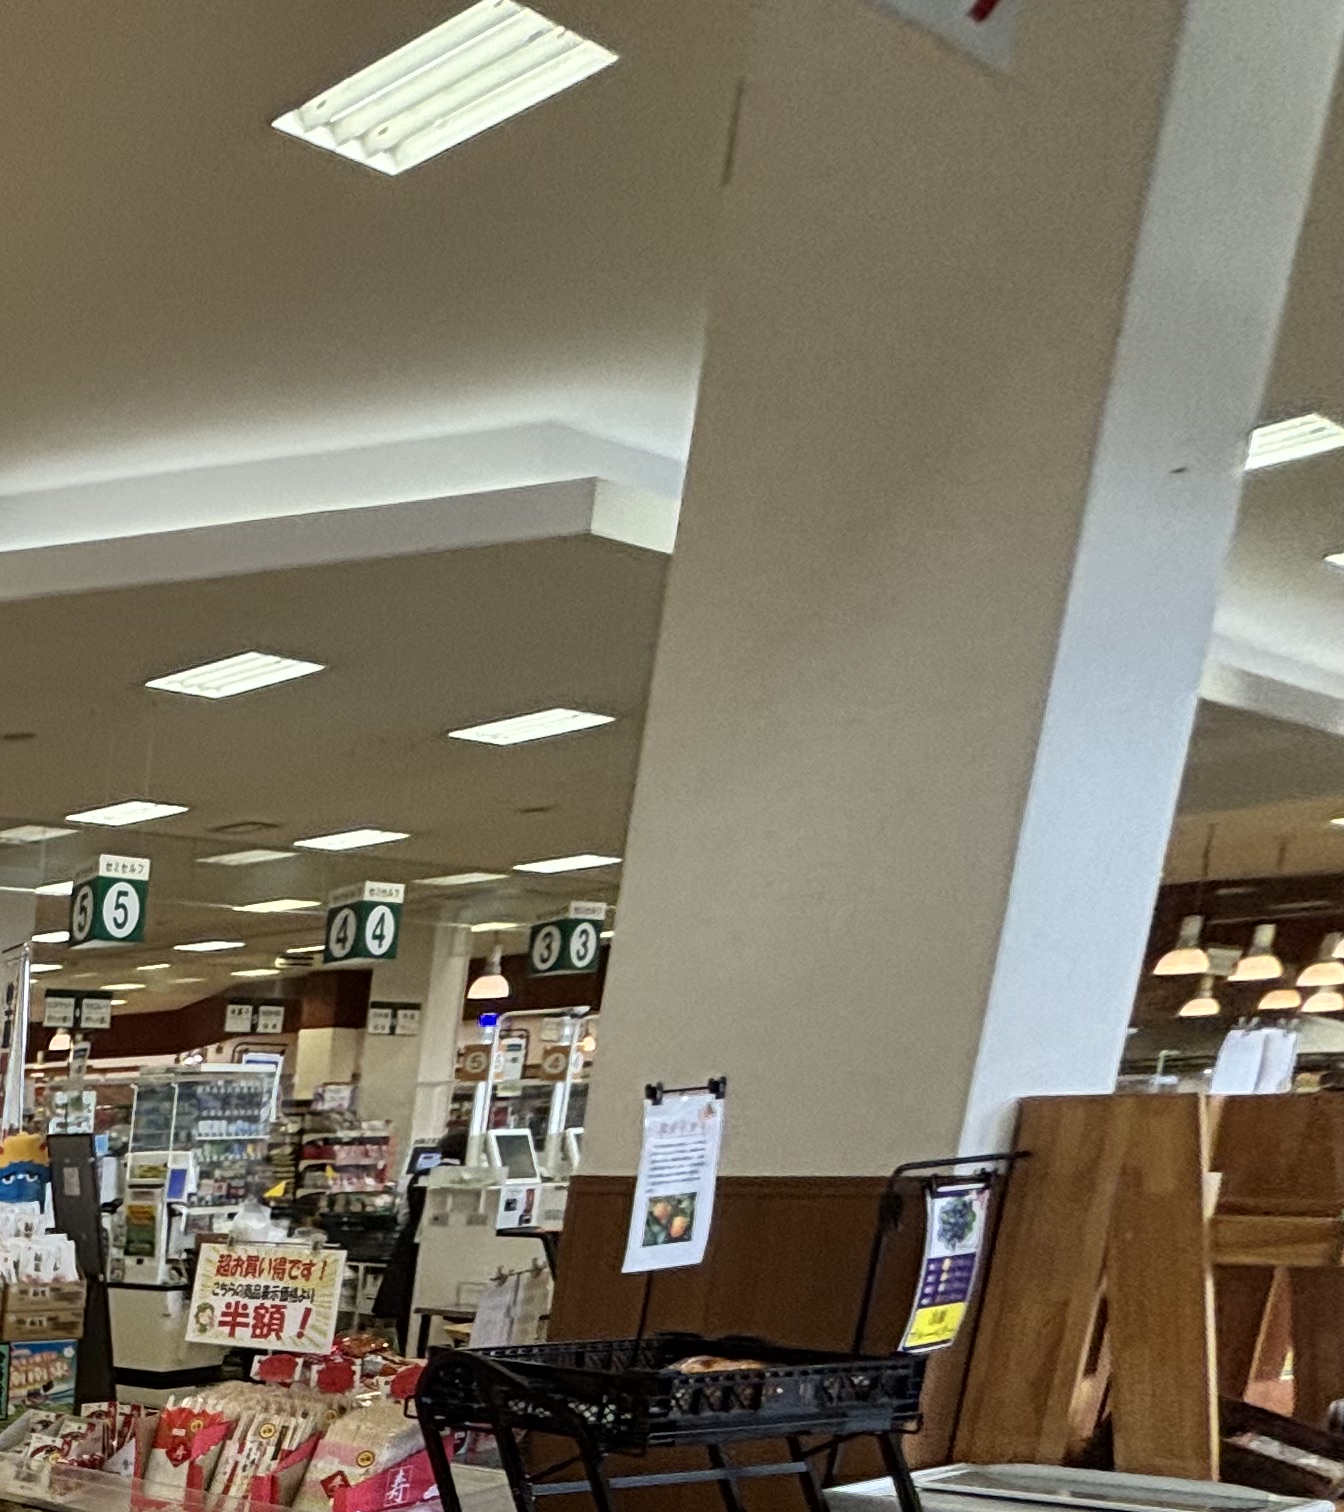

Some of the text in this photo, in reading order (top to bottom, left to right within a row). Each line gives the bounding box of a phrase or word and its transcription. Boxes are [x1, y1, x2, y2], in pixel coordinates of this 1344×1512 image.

[113, 888, 130, 931] 5
[372, 910, 389, 949] 4
[577, 928, 591, 962] 3
[216, 1253, 328, 1281] 超お買い得です！
[217, 1300, 312, 1341] 半額！
[387, 1469, 410, 1504] 寿
